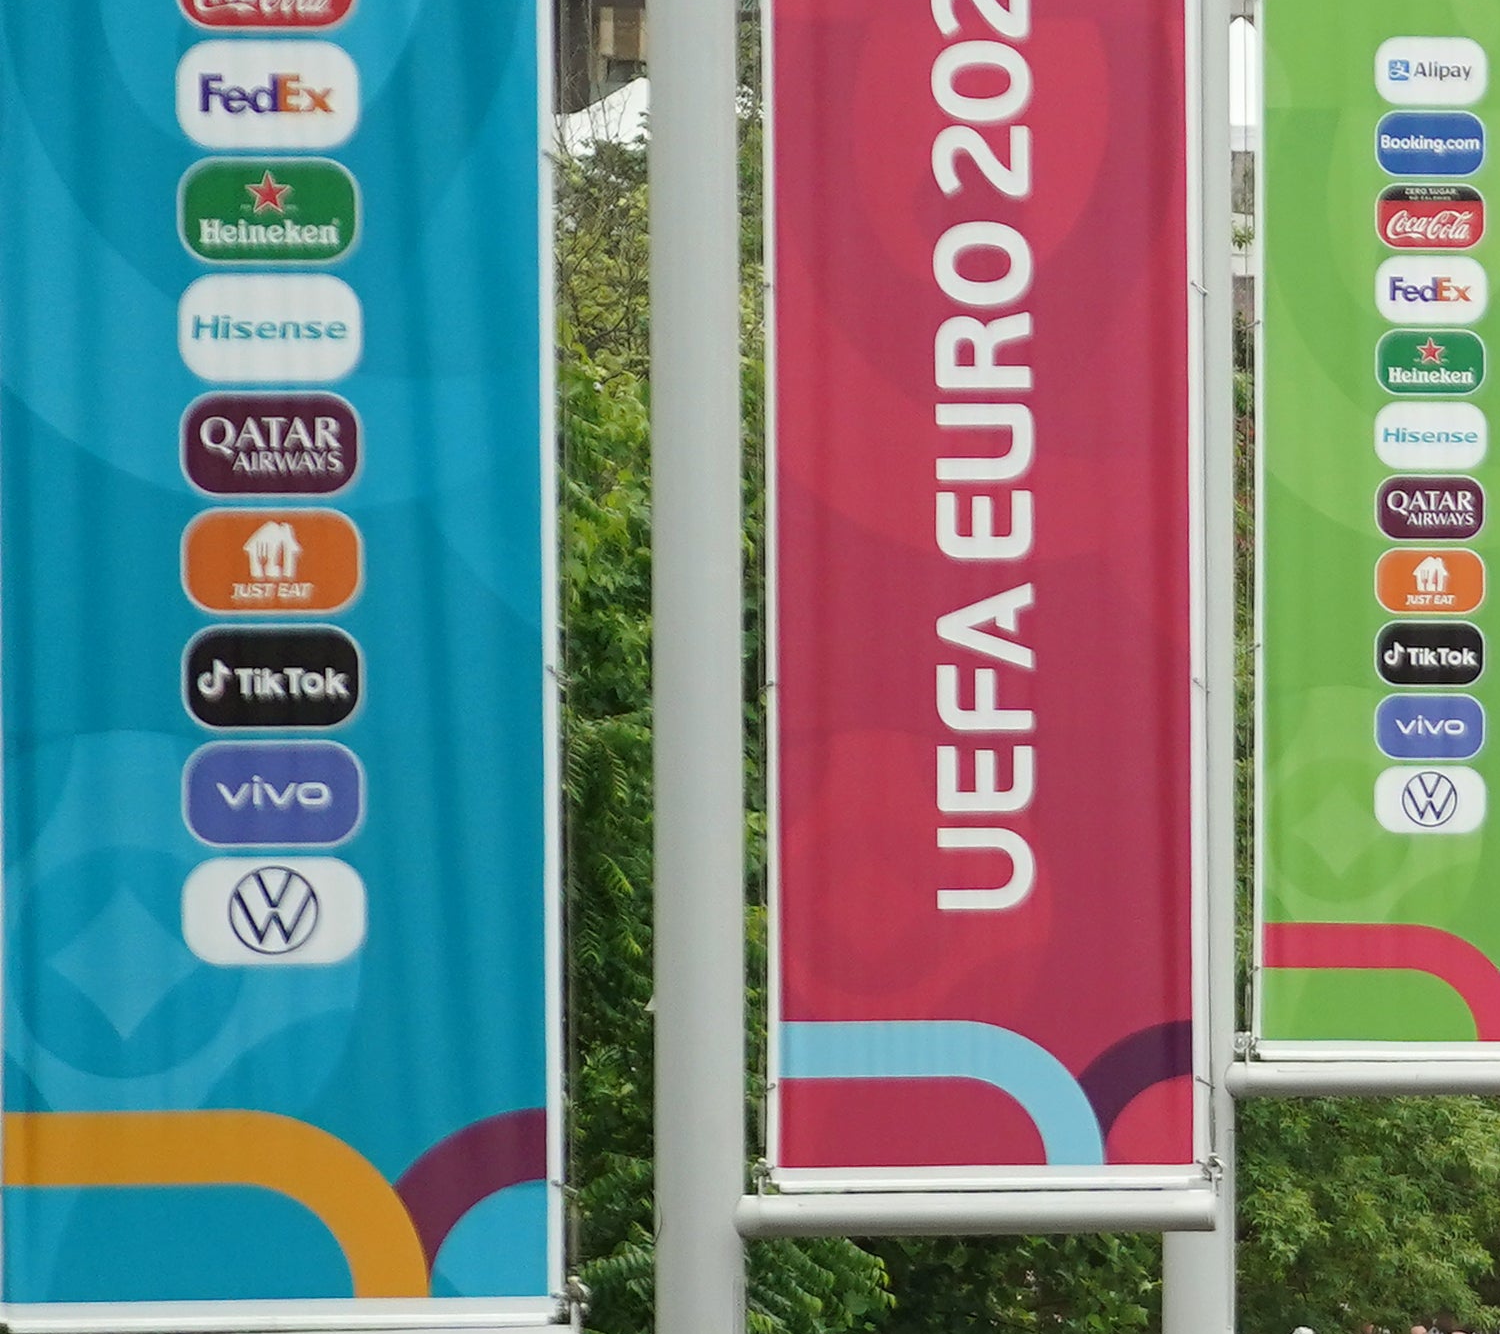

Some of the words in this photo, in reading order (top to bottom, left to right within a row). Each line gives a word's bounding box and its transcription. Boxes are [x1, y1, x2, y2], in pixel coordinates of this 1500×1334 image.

[1413, 60, 1472, 82] Alipay
[199, 73, 334, 115] FedEx
[1380, 133, 1480, 154] Booking.com
[199, 218, 340, 247] Heineken
[1386, 209, 1473, 242] Coca-Cola
[1389, 277, 1472, 302] FedEx
[191, 314, 347, 341] Hisense
[1388, 366, 1474, 385] Heineken
[933, 219, 1035, 561] EURO
[200, 415, 342, 454] QATAR
[1383, 427, 1478, 444] Hisense
[232, 450, 344, 473] AIRWAYS
[1387, 489, 1474, 515] QATAR
[1407, 510, 1475, 527] AIRWAYS
[231, 581, 273, 600] JUST
[276, 581, 313, 599] EAT
[1405, 594, 1430, 605] JUST
[1432, 594, 1456, 605] EAT
[1407, 647, 1477, 666] TikTok
[234, 667, 350, 697] TikTok
[1395, 715, 1466, 736] vivo
[935, 580, 1036, 914] UEFA
[216, 775, 332, 809] vivo
